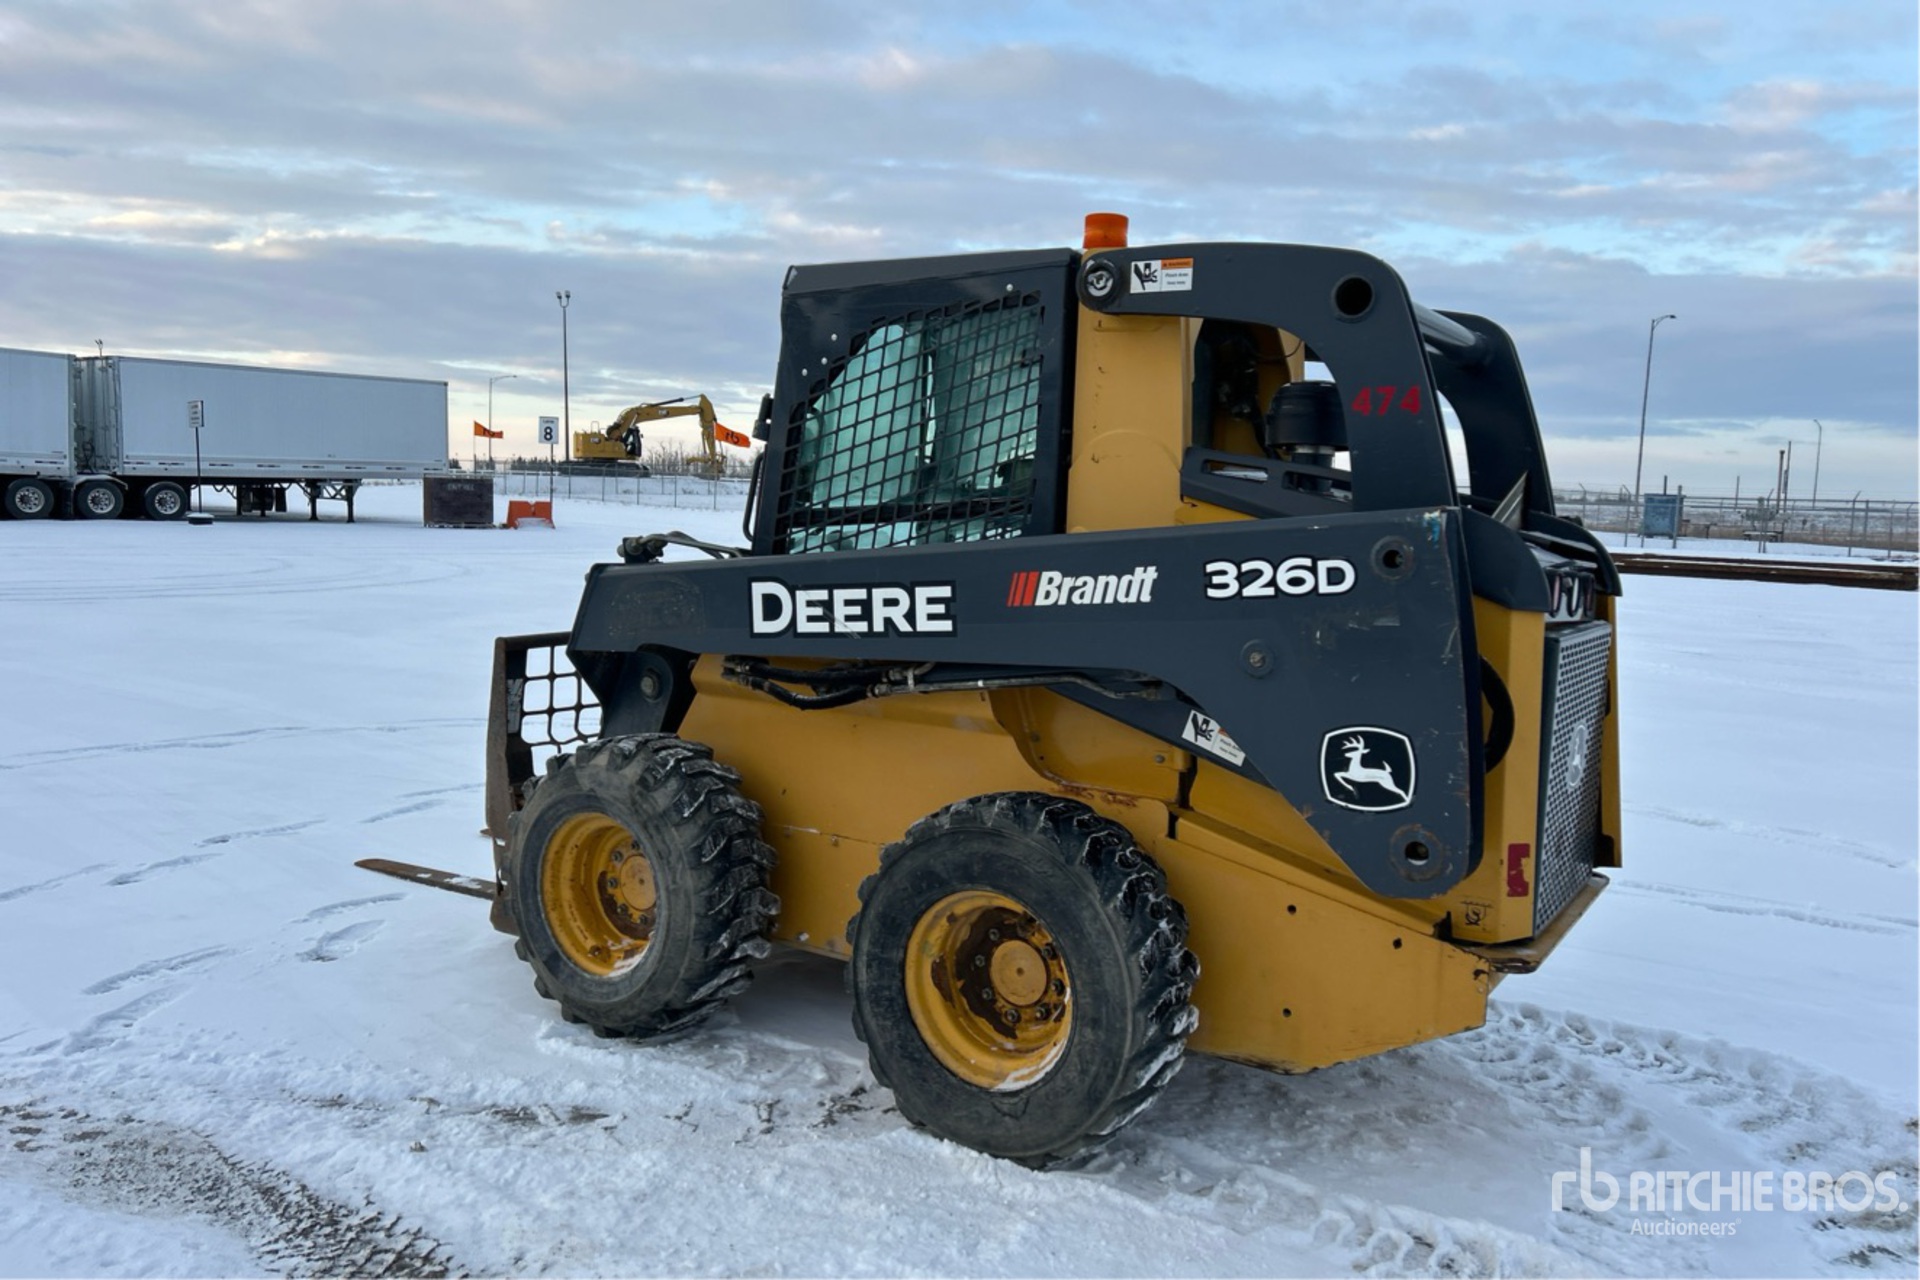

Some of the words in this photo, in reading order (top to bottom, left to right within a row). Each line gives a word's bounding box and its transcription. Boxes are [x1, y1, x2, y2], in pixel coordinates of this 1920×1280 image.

[1351, 385, 1421, 416] 474
[543, 426, 553, 441] 8
[1034, 565, 1159, 607] Brandt
[1205, 557, 1356, 598] 326D
[750, 580, 954, 635] DEERE
